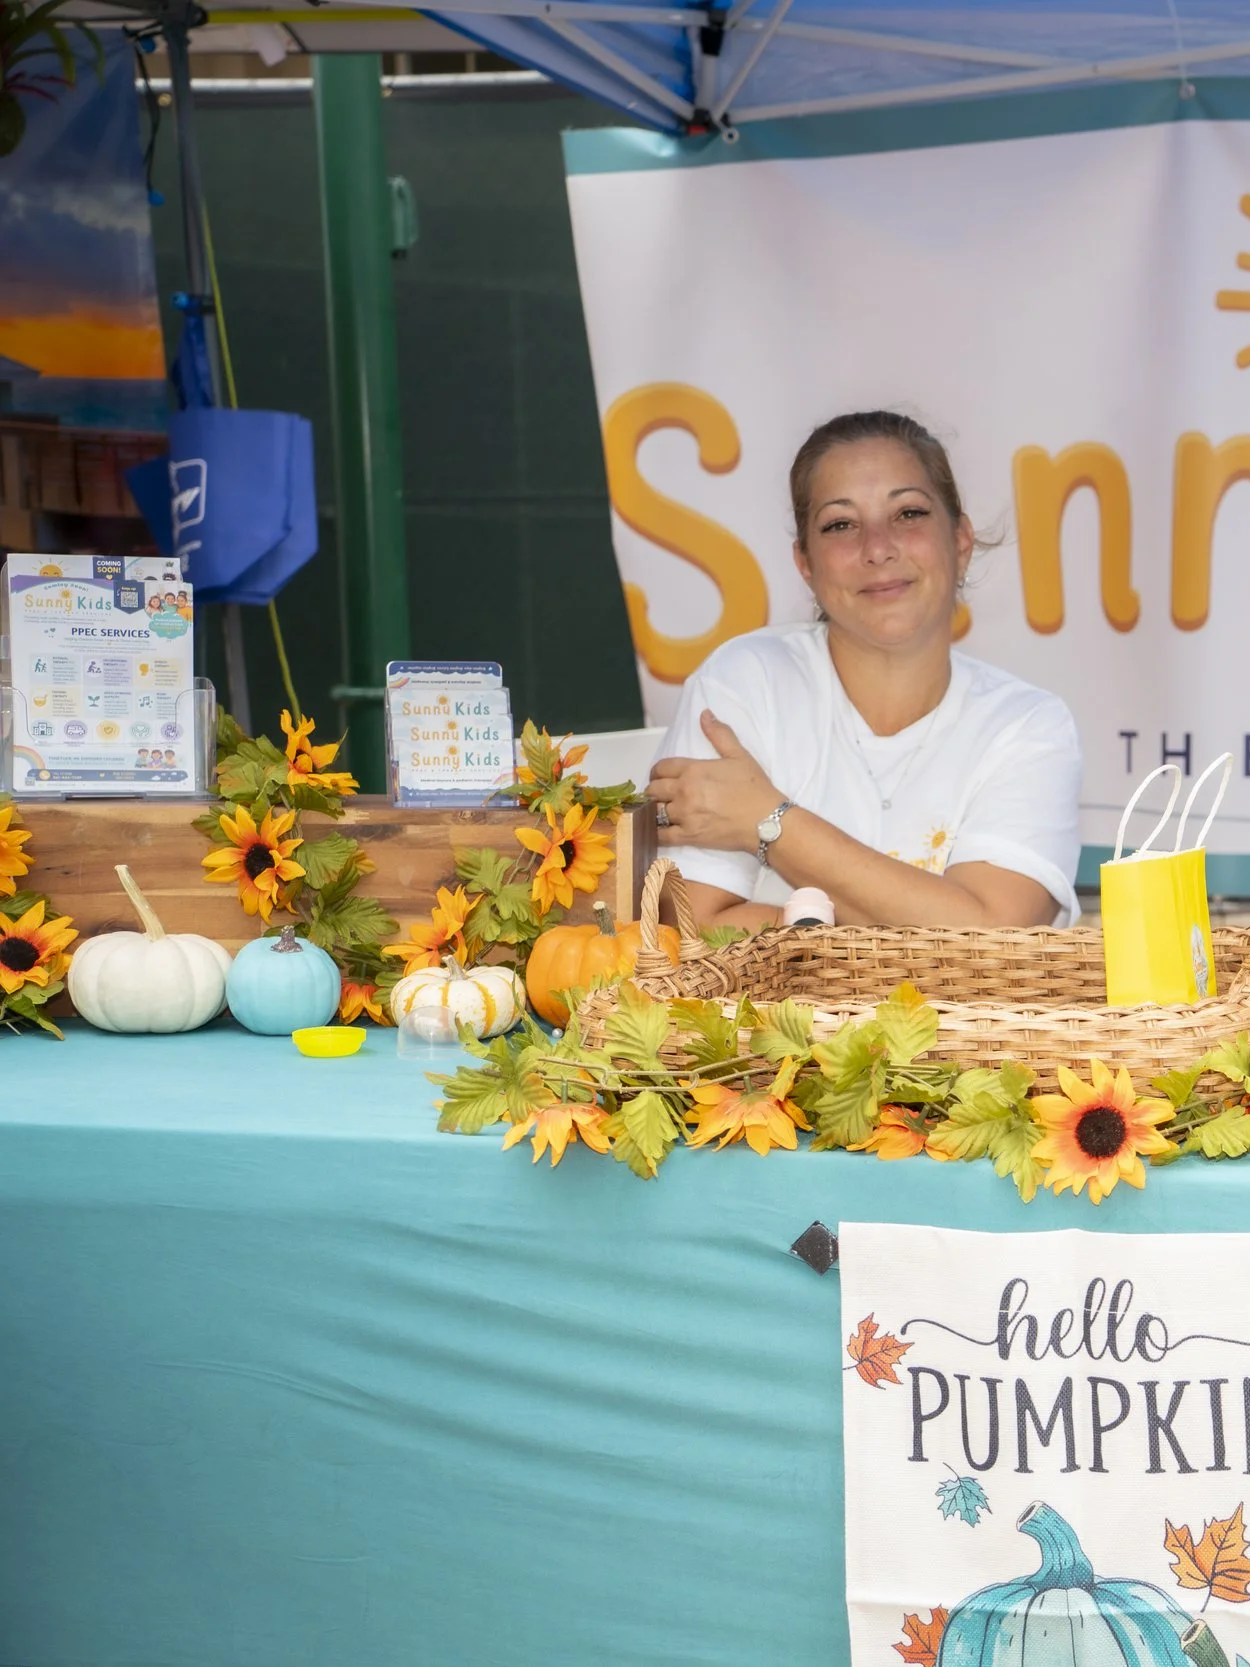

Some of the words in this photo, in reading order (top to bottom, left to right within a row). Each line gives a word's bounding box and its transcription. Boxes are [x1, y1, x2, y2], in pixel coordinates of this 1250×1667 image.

[96, 566, 121, 574] SOON!
[24, 594, 73, 612] Sunny
[77, 596, 112, 610] Kids
[71, 627, 98, 637] PPEC
[100, 628, 150, 639] SERVICES
[455, 702, 490, 716] Kids
[464, 727, 499, 741] Kids
[411, 752, 460, 768] Sunny
[465, 752, 500, 766] Kids
